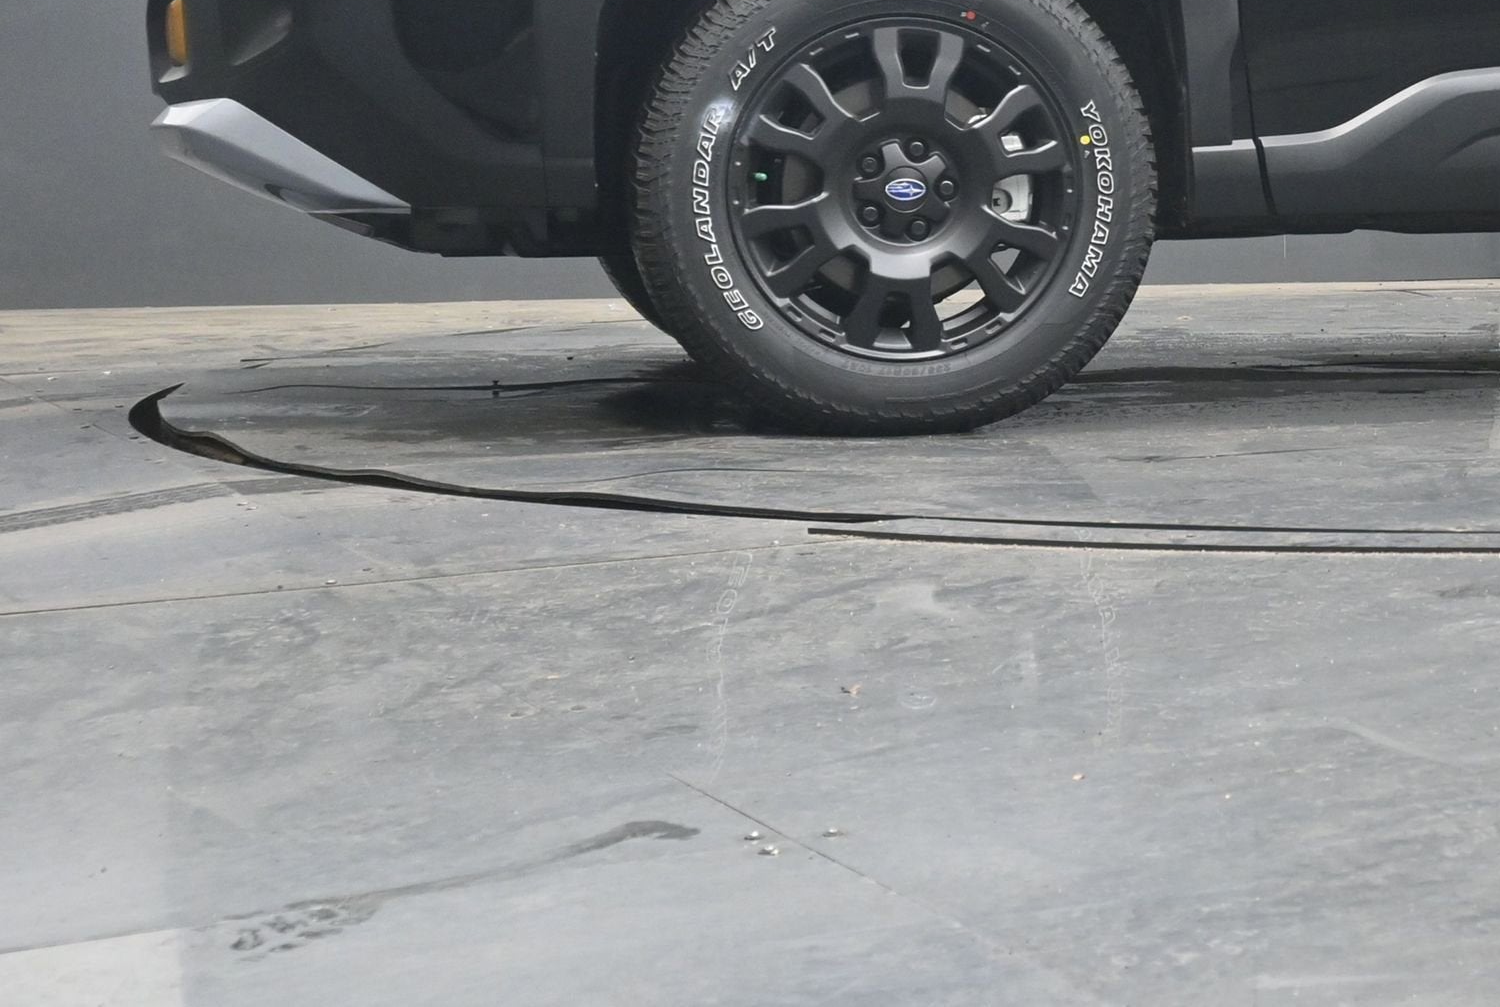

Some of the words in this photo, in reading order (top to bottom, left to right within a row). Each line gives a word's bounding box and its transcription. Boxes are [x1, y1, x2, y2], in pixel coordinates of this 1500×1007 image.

[692, 102, 764, 330] GEOLANDAR
[729, 27, 777, 91] A/T
[1068, 99, 1115, 298] YOKOHAMA
